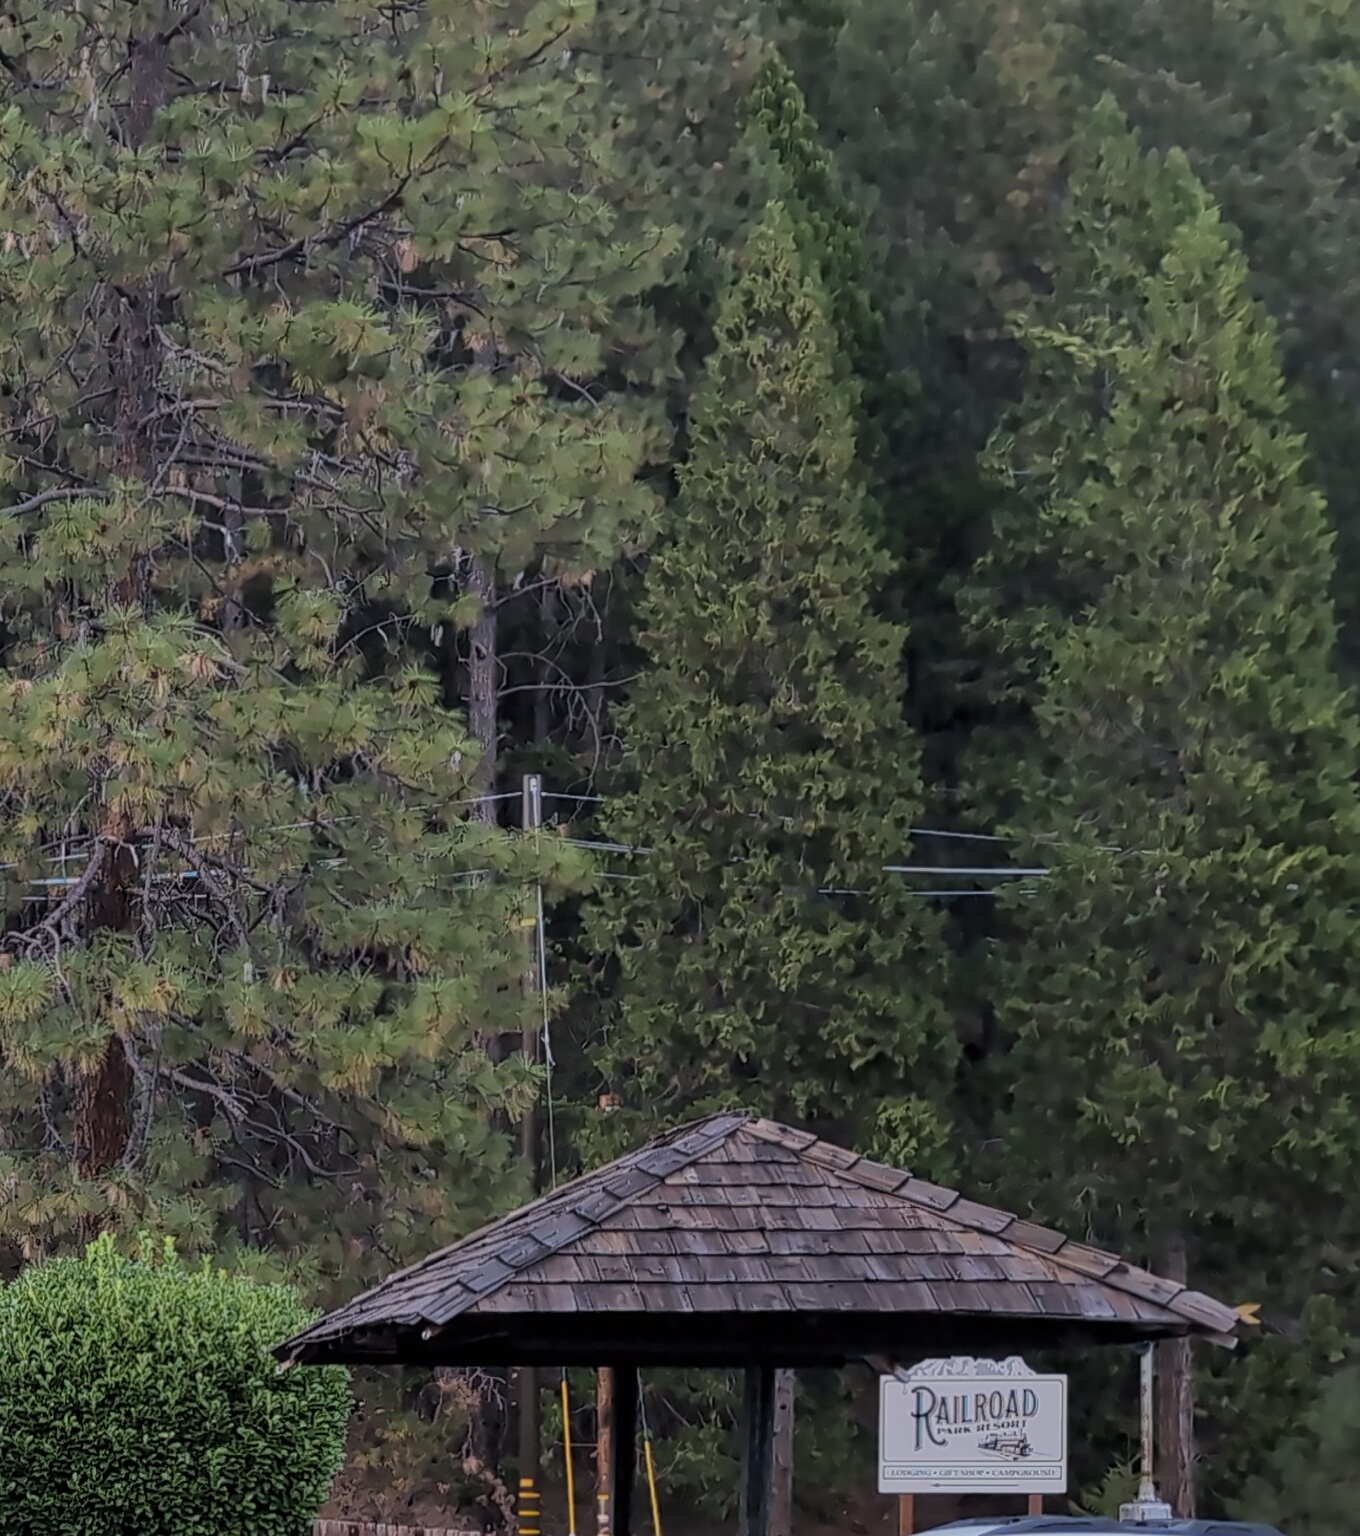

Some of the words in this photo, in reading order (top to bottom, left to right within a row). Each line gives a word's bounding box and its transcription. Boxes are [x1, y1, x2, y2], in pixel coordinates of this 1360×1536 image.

[911, 1386, 1038, 1451] RAILROAD
[937, 1427, 972, 1435] PARK
[977, 1420, 1027, 1432] RESORT
